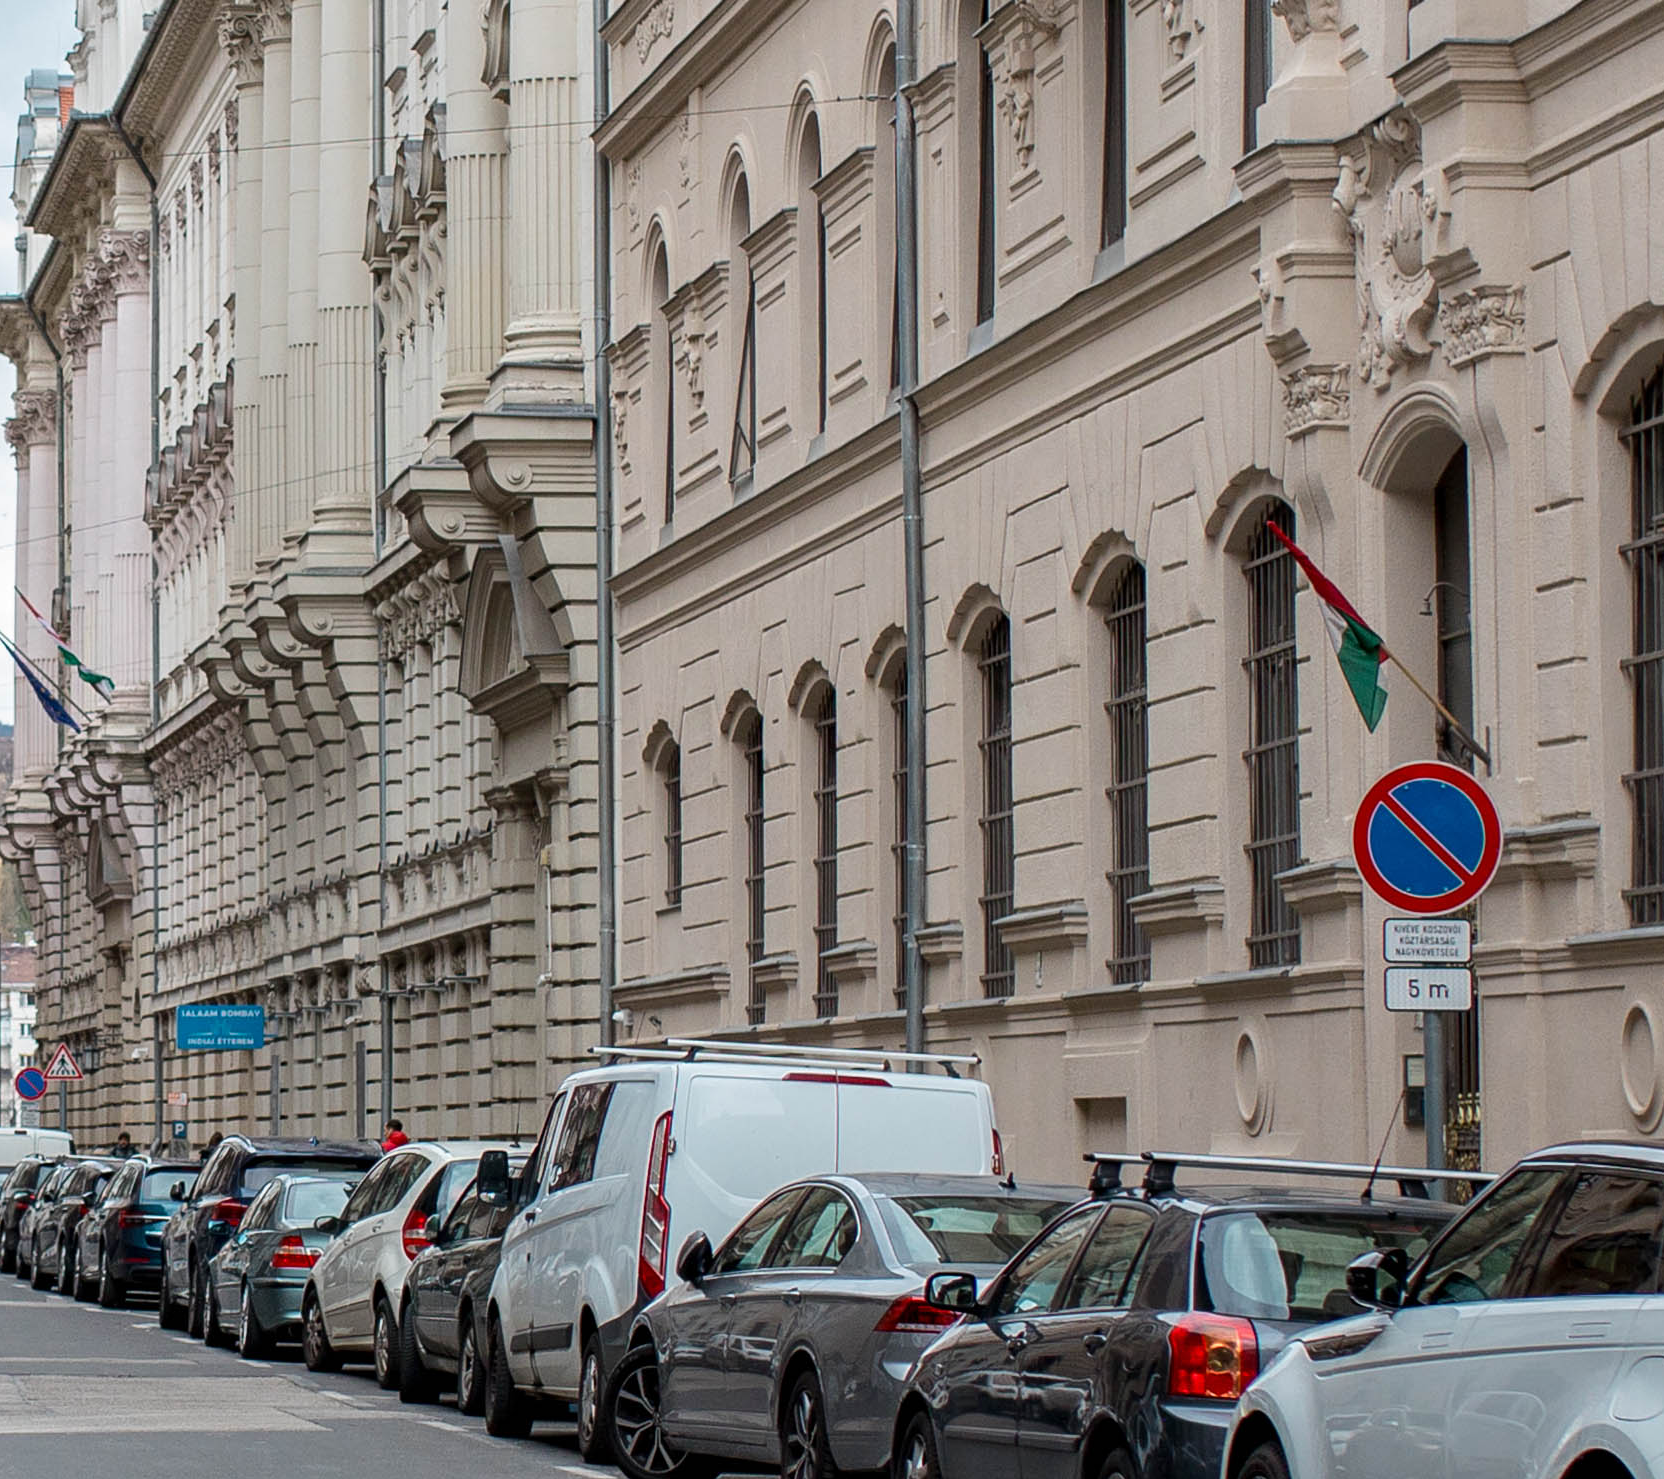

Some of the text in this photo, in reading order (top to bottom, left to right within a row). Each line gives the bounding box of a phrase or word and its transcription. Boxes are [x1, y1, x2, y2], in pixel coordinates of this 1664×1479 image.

[1408, 979, 1449, 998] 5 m
[174, 1122, 185, 1136] P
